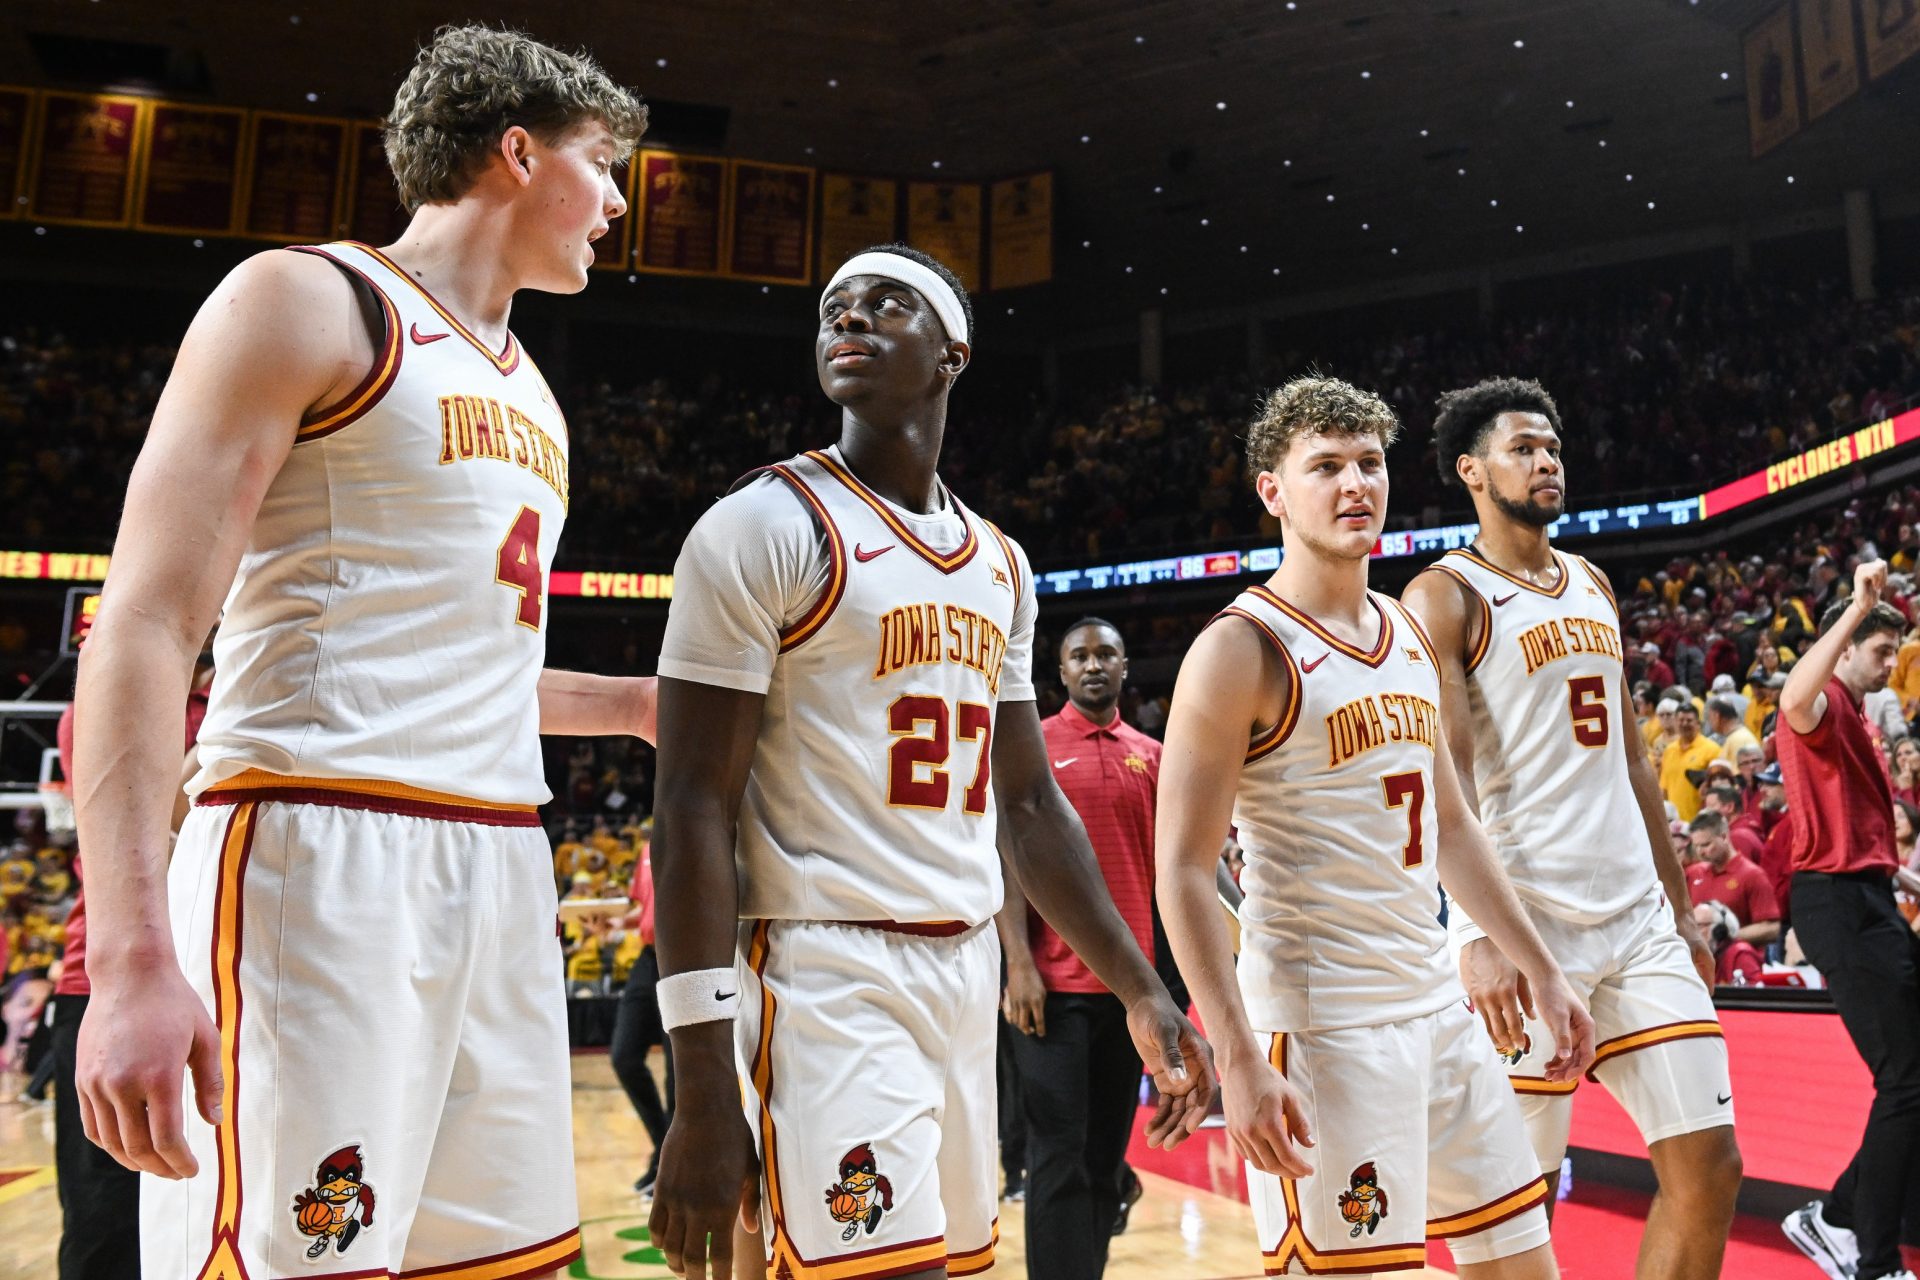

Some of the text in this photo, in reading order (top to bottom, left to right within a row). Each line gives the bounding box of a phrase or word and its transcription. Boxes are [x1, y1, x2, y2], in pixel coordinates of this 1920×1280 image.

[438, 393, 569, 519] IOWA STAT
[1766, 418, 1896, 494] CYCLONES WIN
[49, 553, 112, 581] WIN
[493, 503, 543, 633] 4
[1180, 557, 1205, 579] 86
[1381, 533, 1408, 557] 65
[873, 602, 943, 680] IOWA
[1516, 619, 1569, 677] IOWA
[1324, 694, 1386, 769] IOWA
[1567, 674, 1609, 749] 5
[886, 693, 993, 816] 27
[1380, 768, 1425, 870] 7
